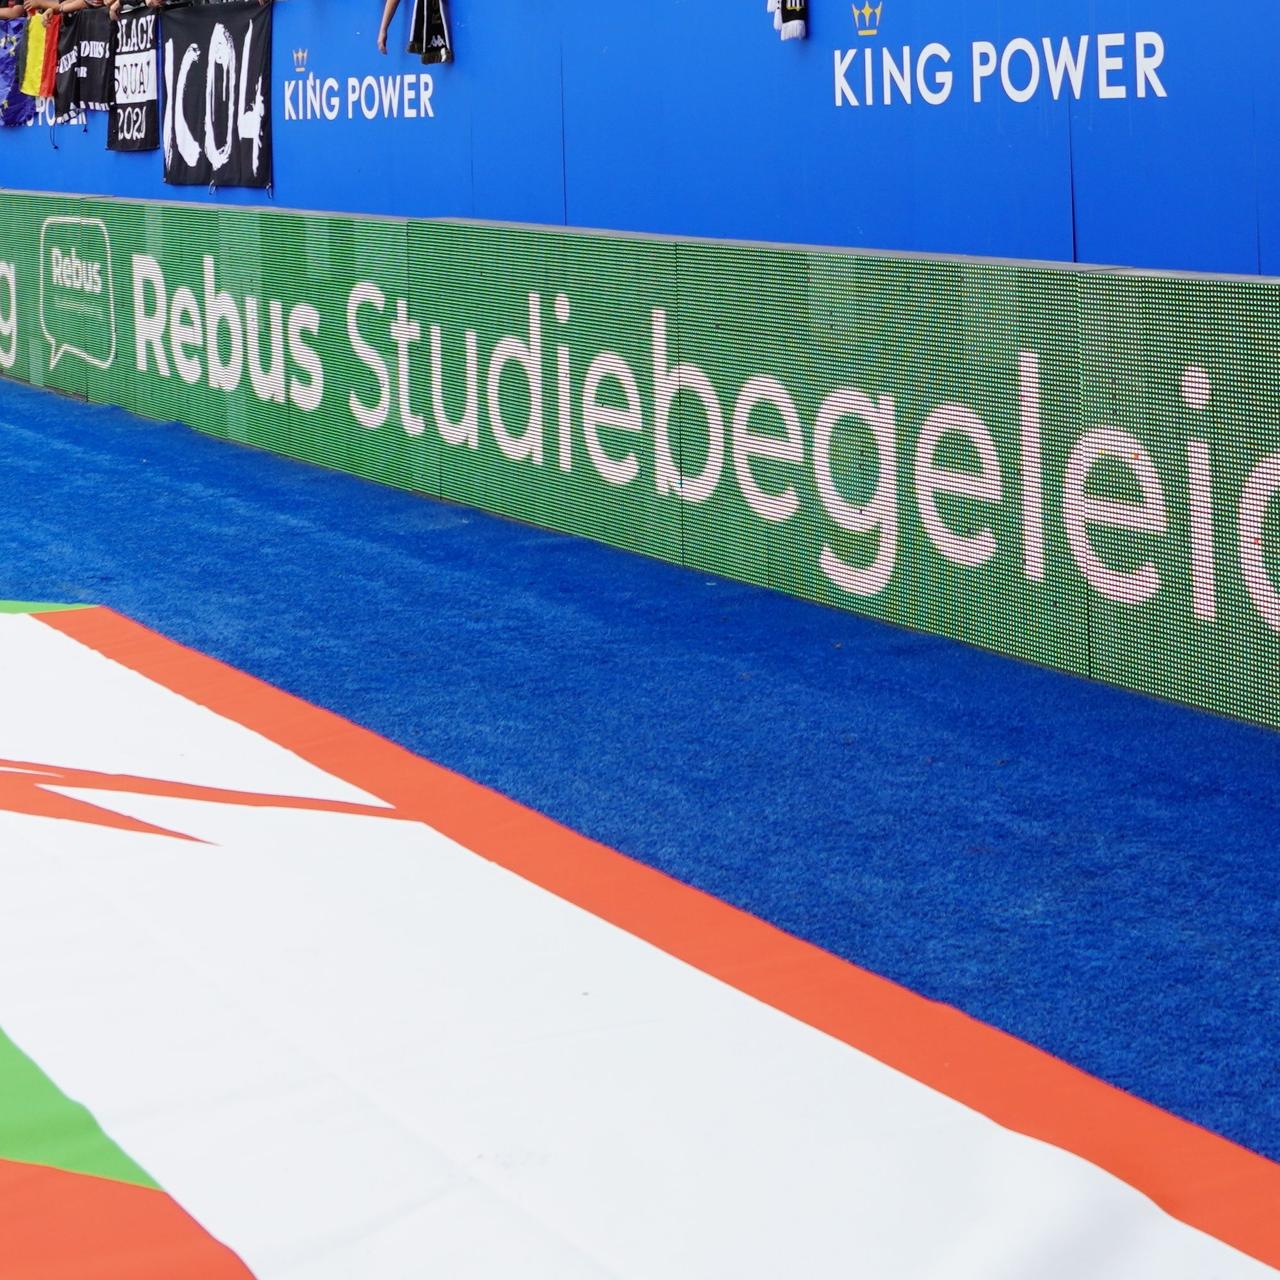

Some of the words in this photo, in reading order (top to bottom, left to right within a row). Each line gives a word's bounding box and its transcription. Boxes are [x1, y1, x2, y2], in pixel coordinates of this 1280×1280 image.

[284, 76, 340, 121] KING
[347, 73, 435, 120] POWER
[833, 42, 953, 108] KING
[971, 30, 1168, 104] POWER
[50, 246, 102, 294] Rebus
[131, 254, 324, 413] Rebus
